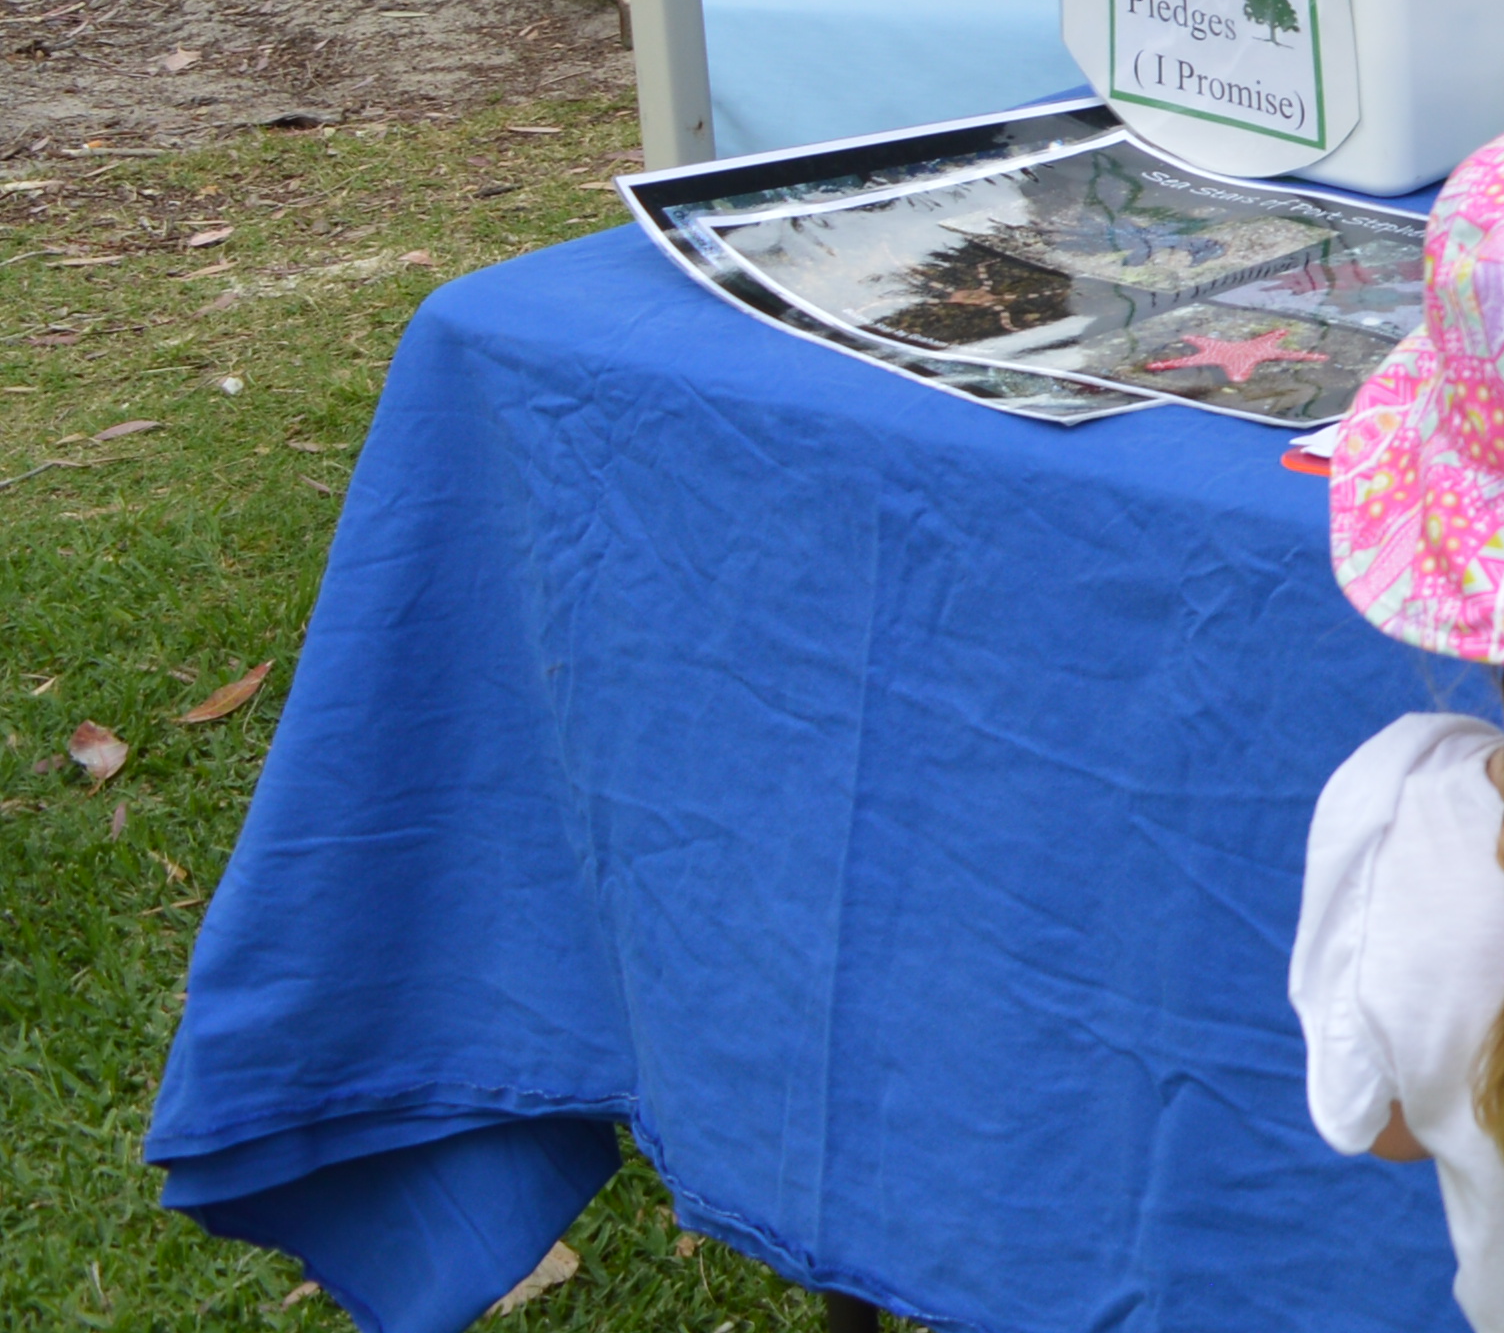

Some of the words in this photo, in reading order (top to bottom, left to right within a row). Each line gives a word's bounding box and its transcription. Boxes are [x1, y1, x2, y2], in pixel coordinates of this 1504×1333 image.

[1176, 58, 1306, 131] Promise)
[1142, 170, 1190, 191] Sea
[1190, 186, 1258, 205] Stars
[1260, 196, 1299, 211] of
[1291, 203, 1343, 221] Port
